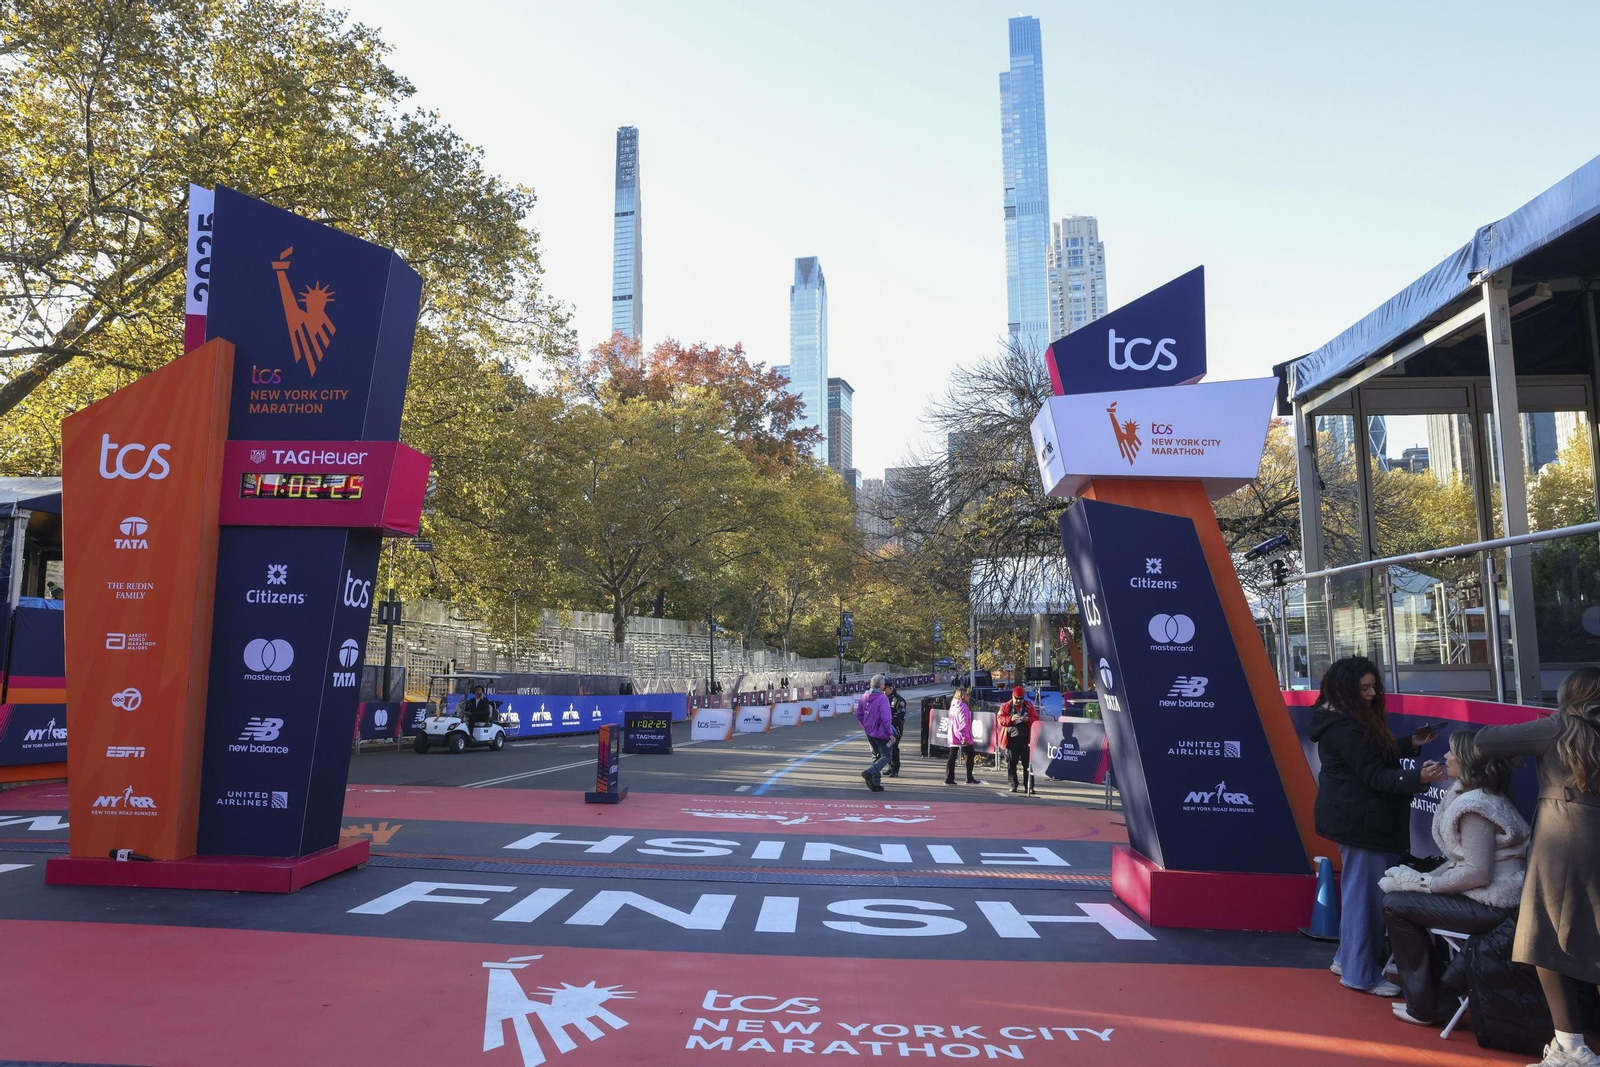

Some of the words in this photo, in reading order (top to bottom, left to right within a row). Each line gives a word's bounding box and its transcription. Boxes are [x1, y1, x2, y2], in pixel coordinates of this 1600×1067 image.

[194, 212, 214, 302] 2025
[1108, 328, 1178, 370] tcs
[252, 365, 282, 384] tcs
[250, 390, 280, 400] NEW
[284, 390, 318, 400] YORK
[320, 390, 348, 400] CITY
[249, 404, 323, 413] MARATHON
[1152, 422, 1172, 434] tcs
[100, 433, 170, 480] tcs
[114, 539, 148, 549] TATA
[344, 569, 370, 608] tcs
[1130, 577, 1178, 589] Citizens
[246, 589, 305, 604] Citizens
[1080, 588, 1101, 626] tcs
[333, 672, 355, 687] TATA
[1104, 694, 1121, 712] TATA
[1179, 700, 1215, 708] balance
[697, 720, 709, 729] tcs
[106, 746, 145, 757] ESPN
[229, 744, 248, 752] new
[250, 744, 289, 754] balance
[1047, 742, 1062, 760] tcs
[216, 798, 268, 806] AIRLINES
[502, 832, 1071, 868] FINISH
[346, 881, 1158, 941] FINISH
[702, 989, 820, 1015] tcs
[692, 1017, 822, 1035] NEW
[837, 1022, 988, 1040] YORK
[999, 1026, 1115, 1042] CITY
[685, 1034, 1024, 1060] MARATHON
